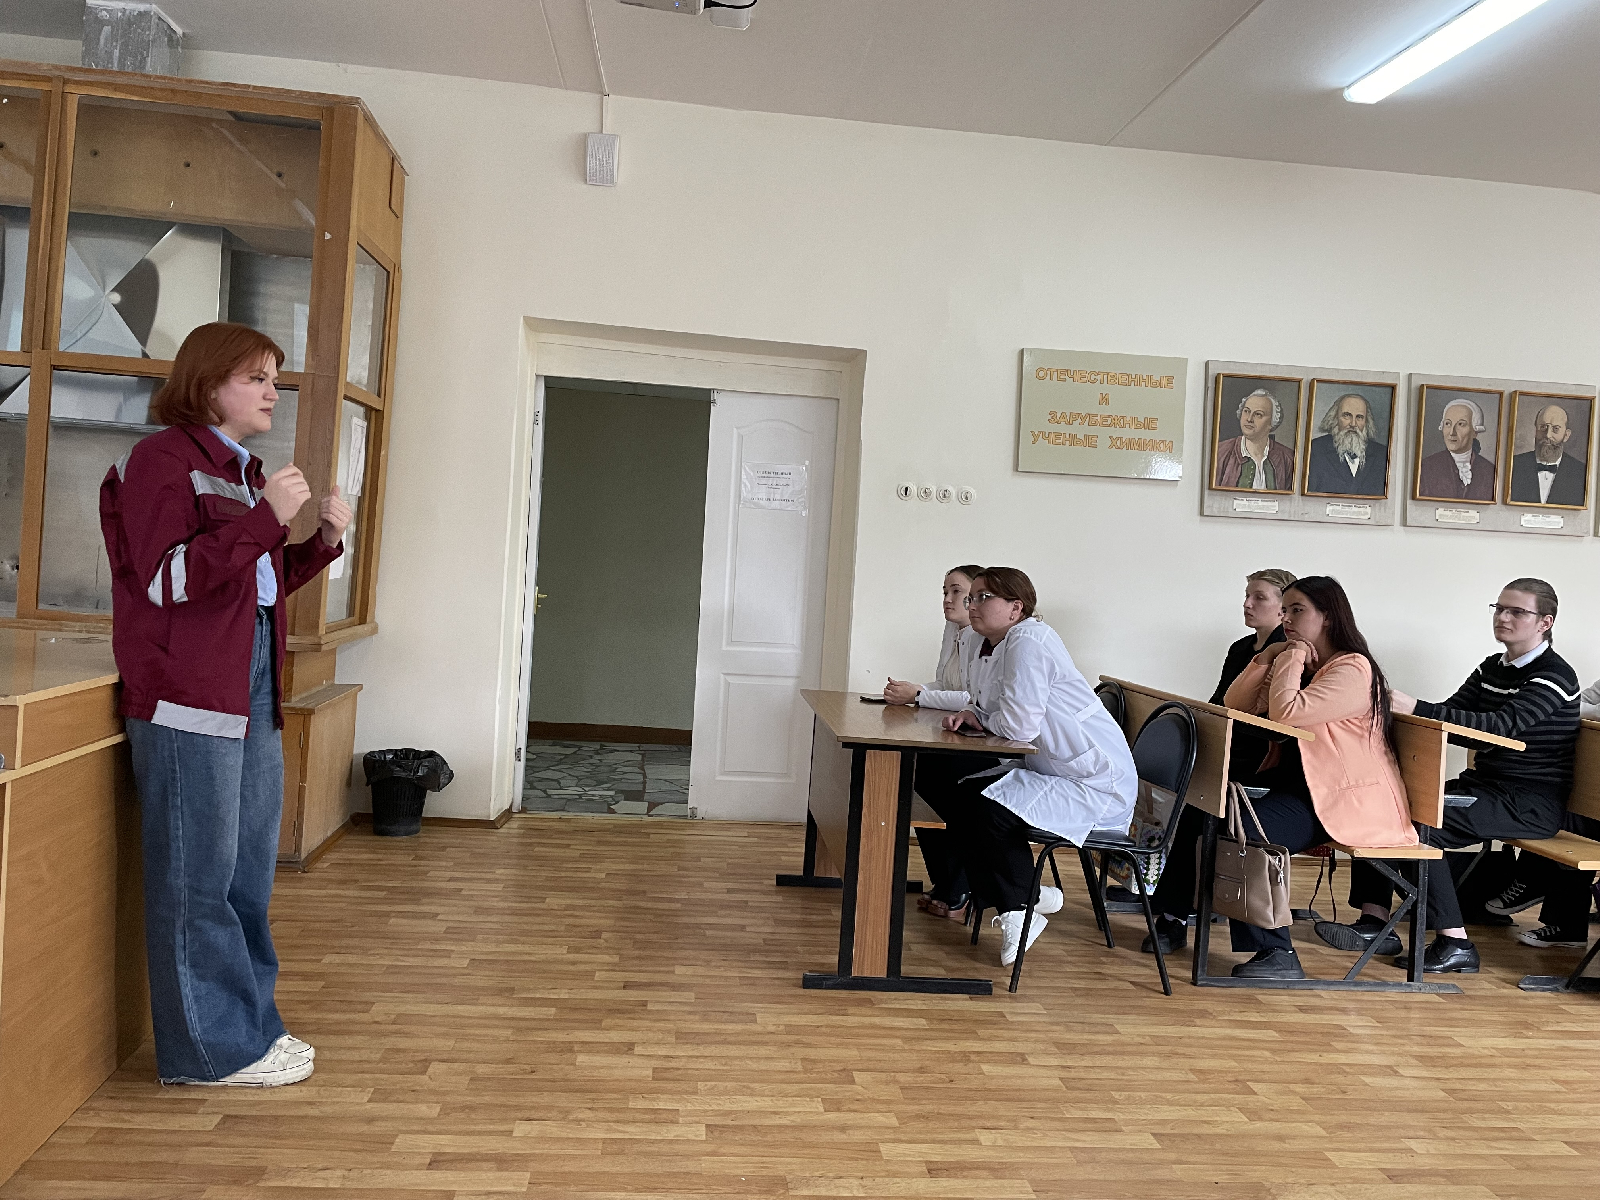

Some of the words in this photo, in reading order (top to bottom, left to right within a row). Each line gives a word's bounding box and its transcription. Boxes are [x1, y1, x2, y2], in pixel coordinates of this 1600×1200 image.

[1035, 367, 1174, 389] ОТЕЧЕСТВЕННЫЕ
[1098, 393, 1110, 406] И
[1047, 411, 1158, 430] ЗАРУБЕЖНЫЕ
[1030, 431, 1098, 448] УЧЕНЫЕ
[1108, 436, 1174, 453] ХИМИКИ
